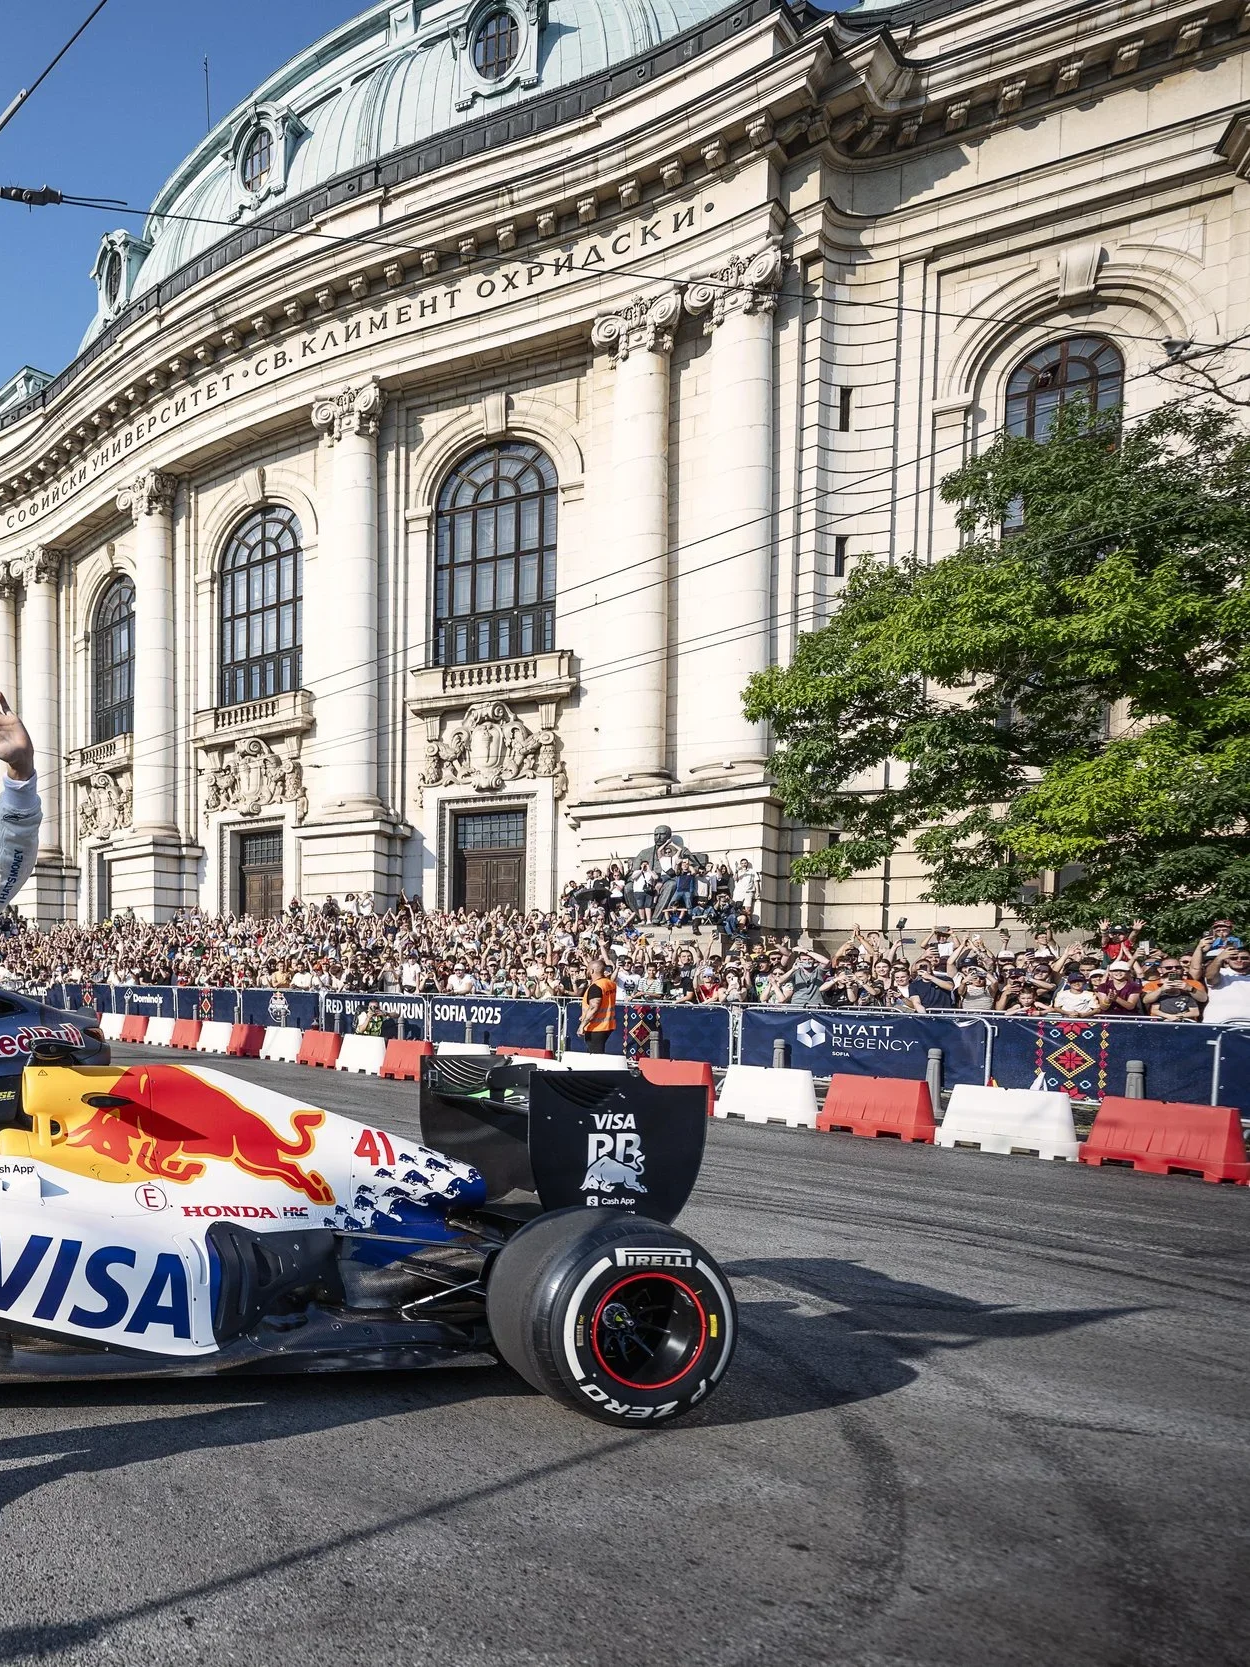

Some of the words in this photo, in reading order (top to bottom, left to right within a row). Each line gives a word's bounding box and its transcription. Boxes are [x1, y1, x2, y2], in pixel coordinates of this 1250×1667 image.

[6, 466, 87, 529] СОФИЙСКИ
[92, 373, 235, 472] УНИВЕРСИТЕТ
[301, 288, 461, 358] КЛИМЕНТ
[476, 205, 695, 298] ОХРИДСКИ
[132, 993, 163, 1004] Domino's
[325, 998, 343, 1014] RED
[434, 1005, 467, 1022] SOFIA
[470, 1005, 502, 1025] 2025
[831, 1023, 894, 1037] HYATT
[590, 1113, 637, 1130] VISA
[353, 1129, 397, 1166] 41
[601, 1197, 619, 1205] Cash
[620, 1197, 636, 1206] App
[180, 1205, 279, 1219] HONDA
[614, 1247, 693, 1268] PIRELLI
[579, 1382, 679, 1419] ZERO
